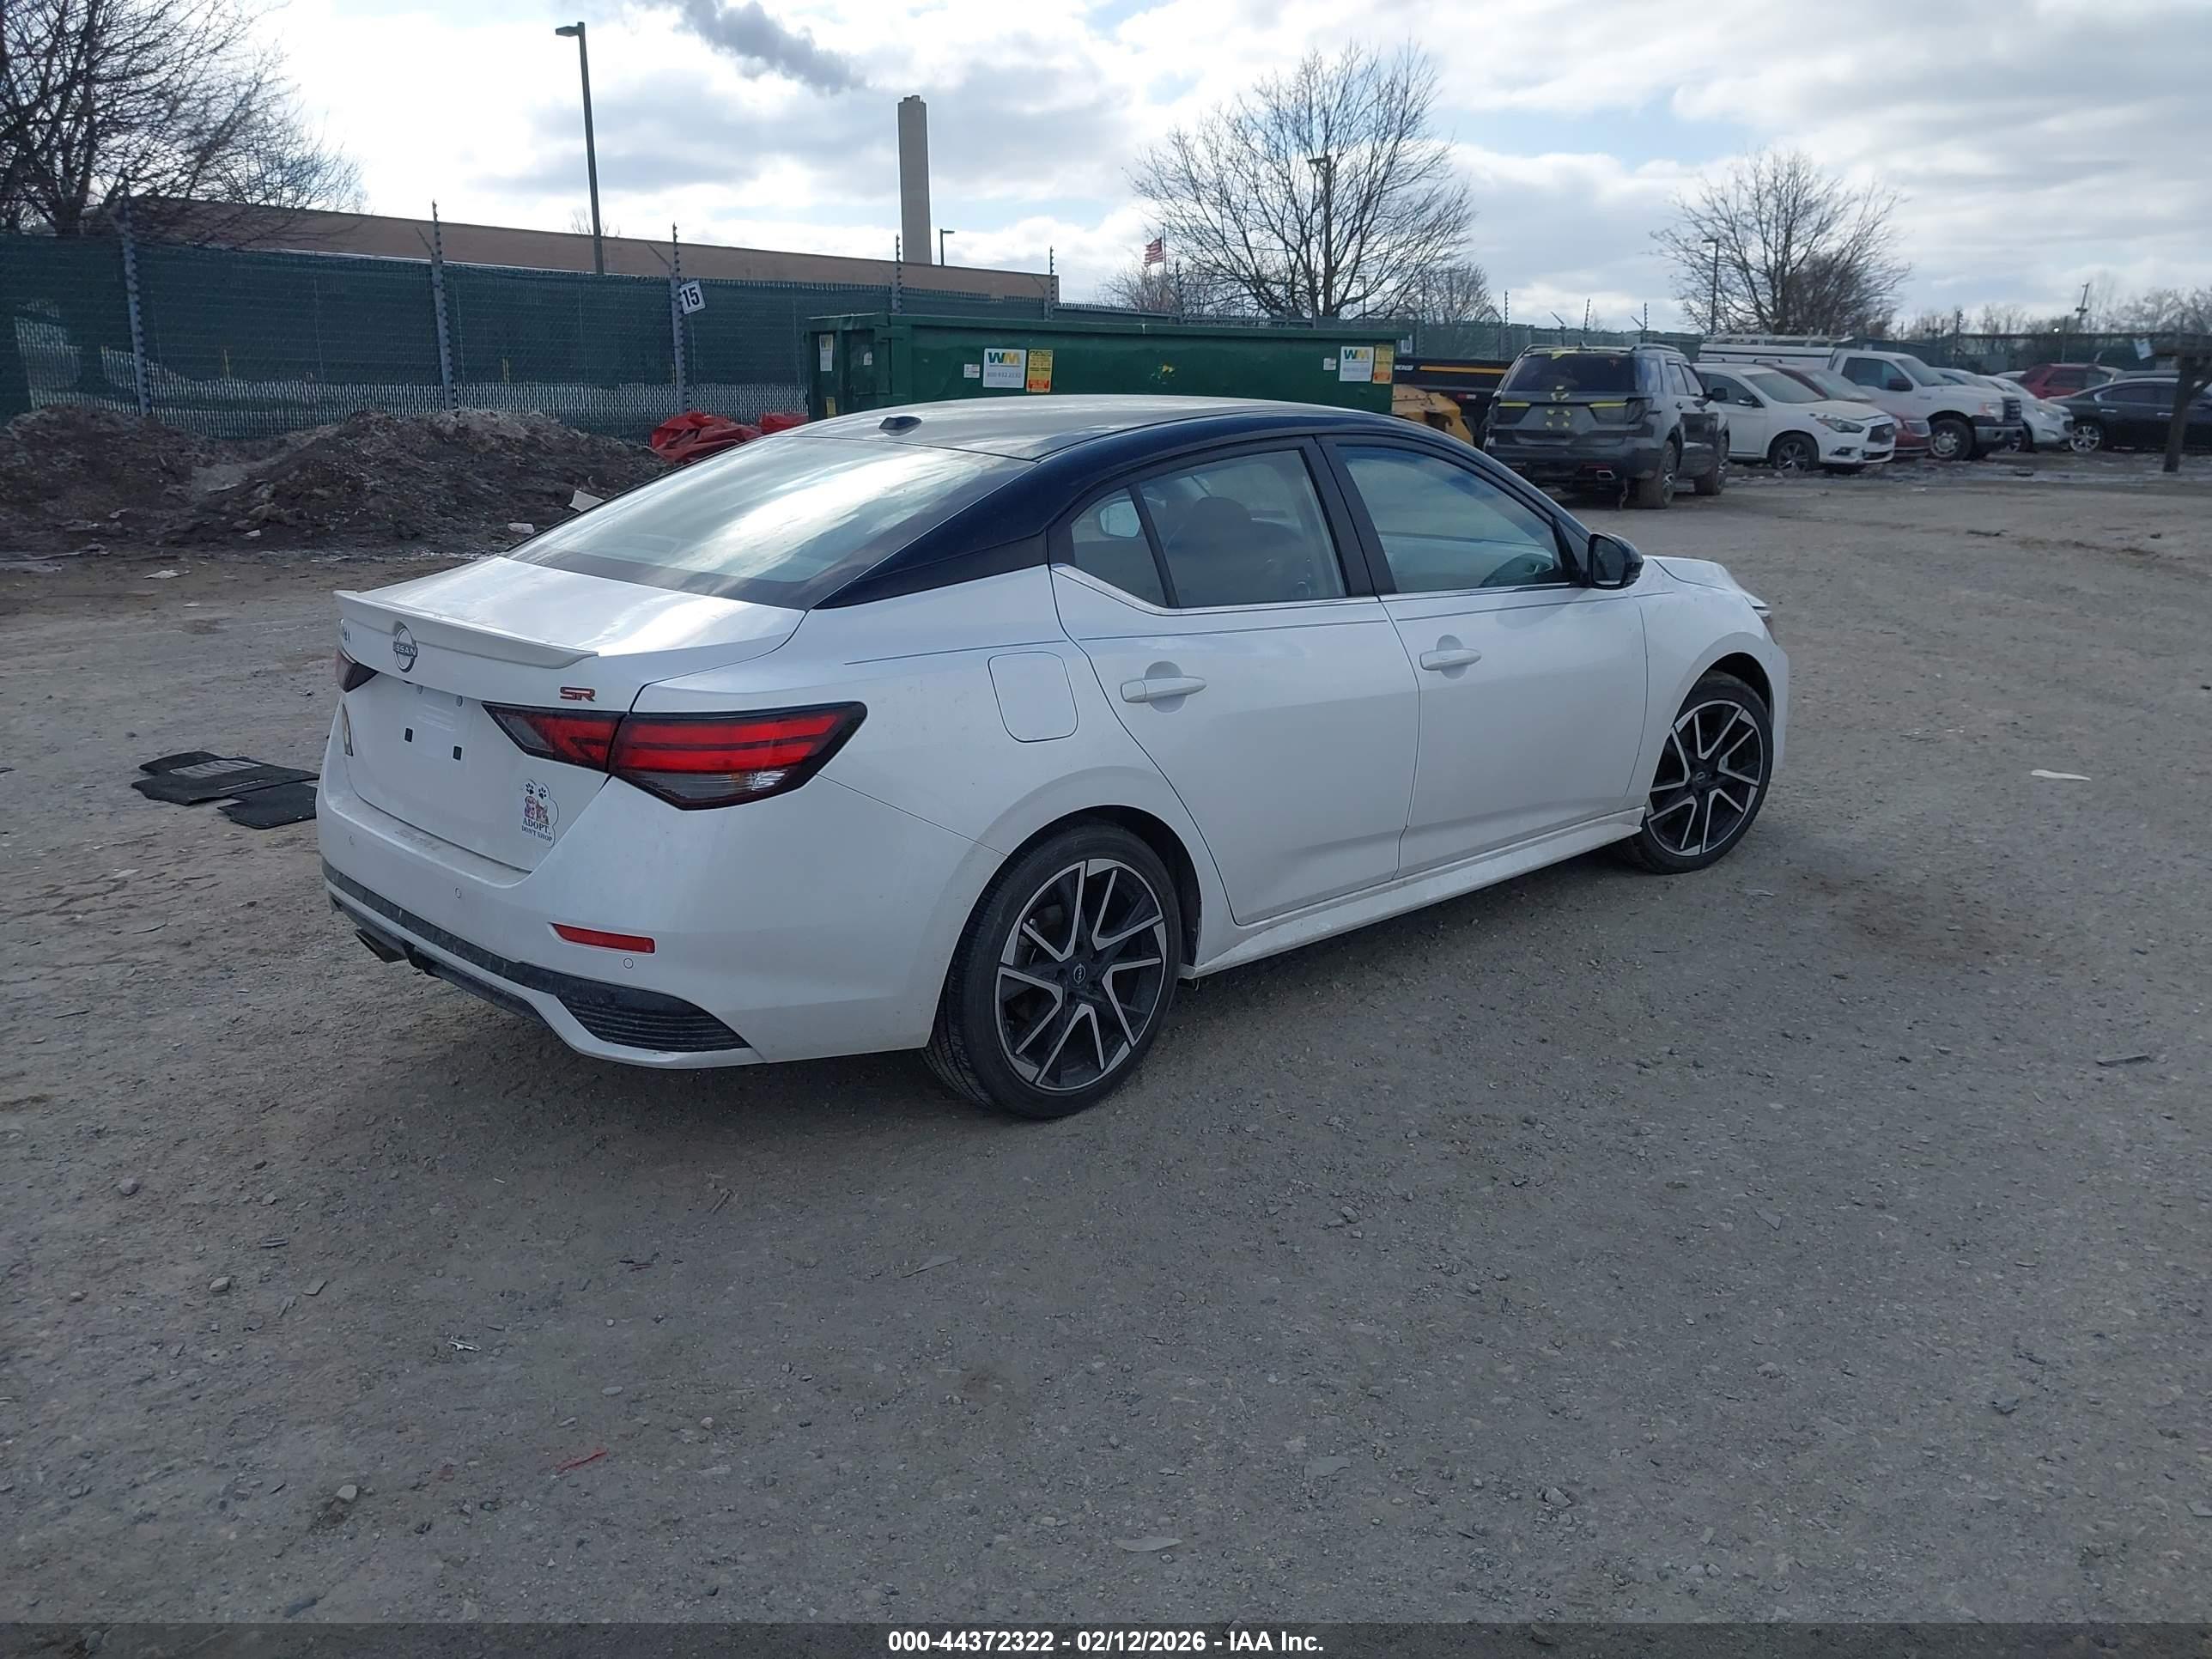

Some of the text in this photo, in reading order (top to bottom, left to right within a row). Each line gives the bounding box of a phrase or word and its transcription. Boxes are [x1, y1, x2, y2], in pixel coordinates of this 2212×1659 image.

[683, 287, 700, 307] 15
[988, 352, 1020, 364] WM
[560, 686, 595, 702] SR
